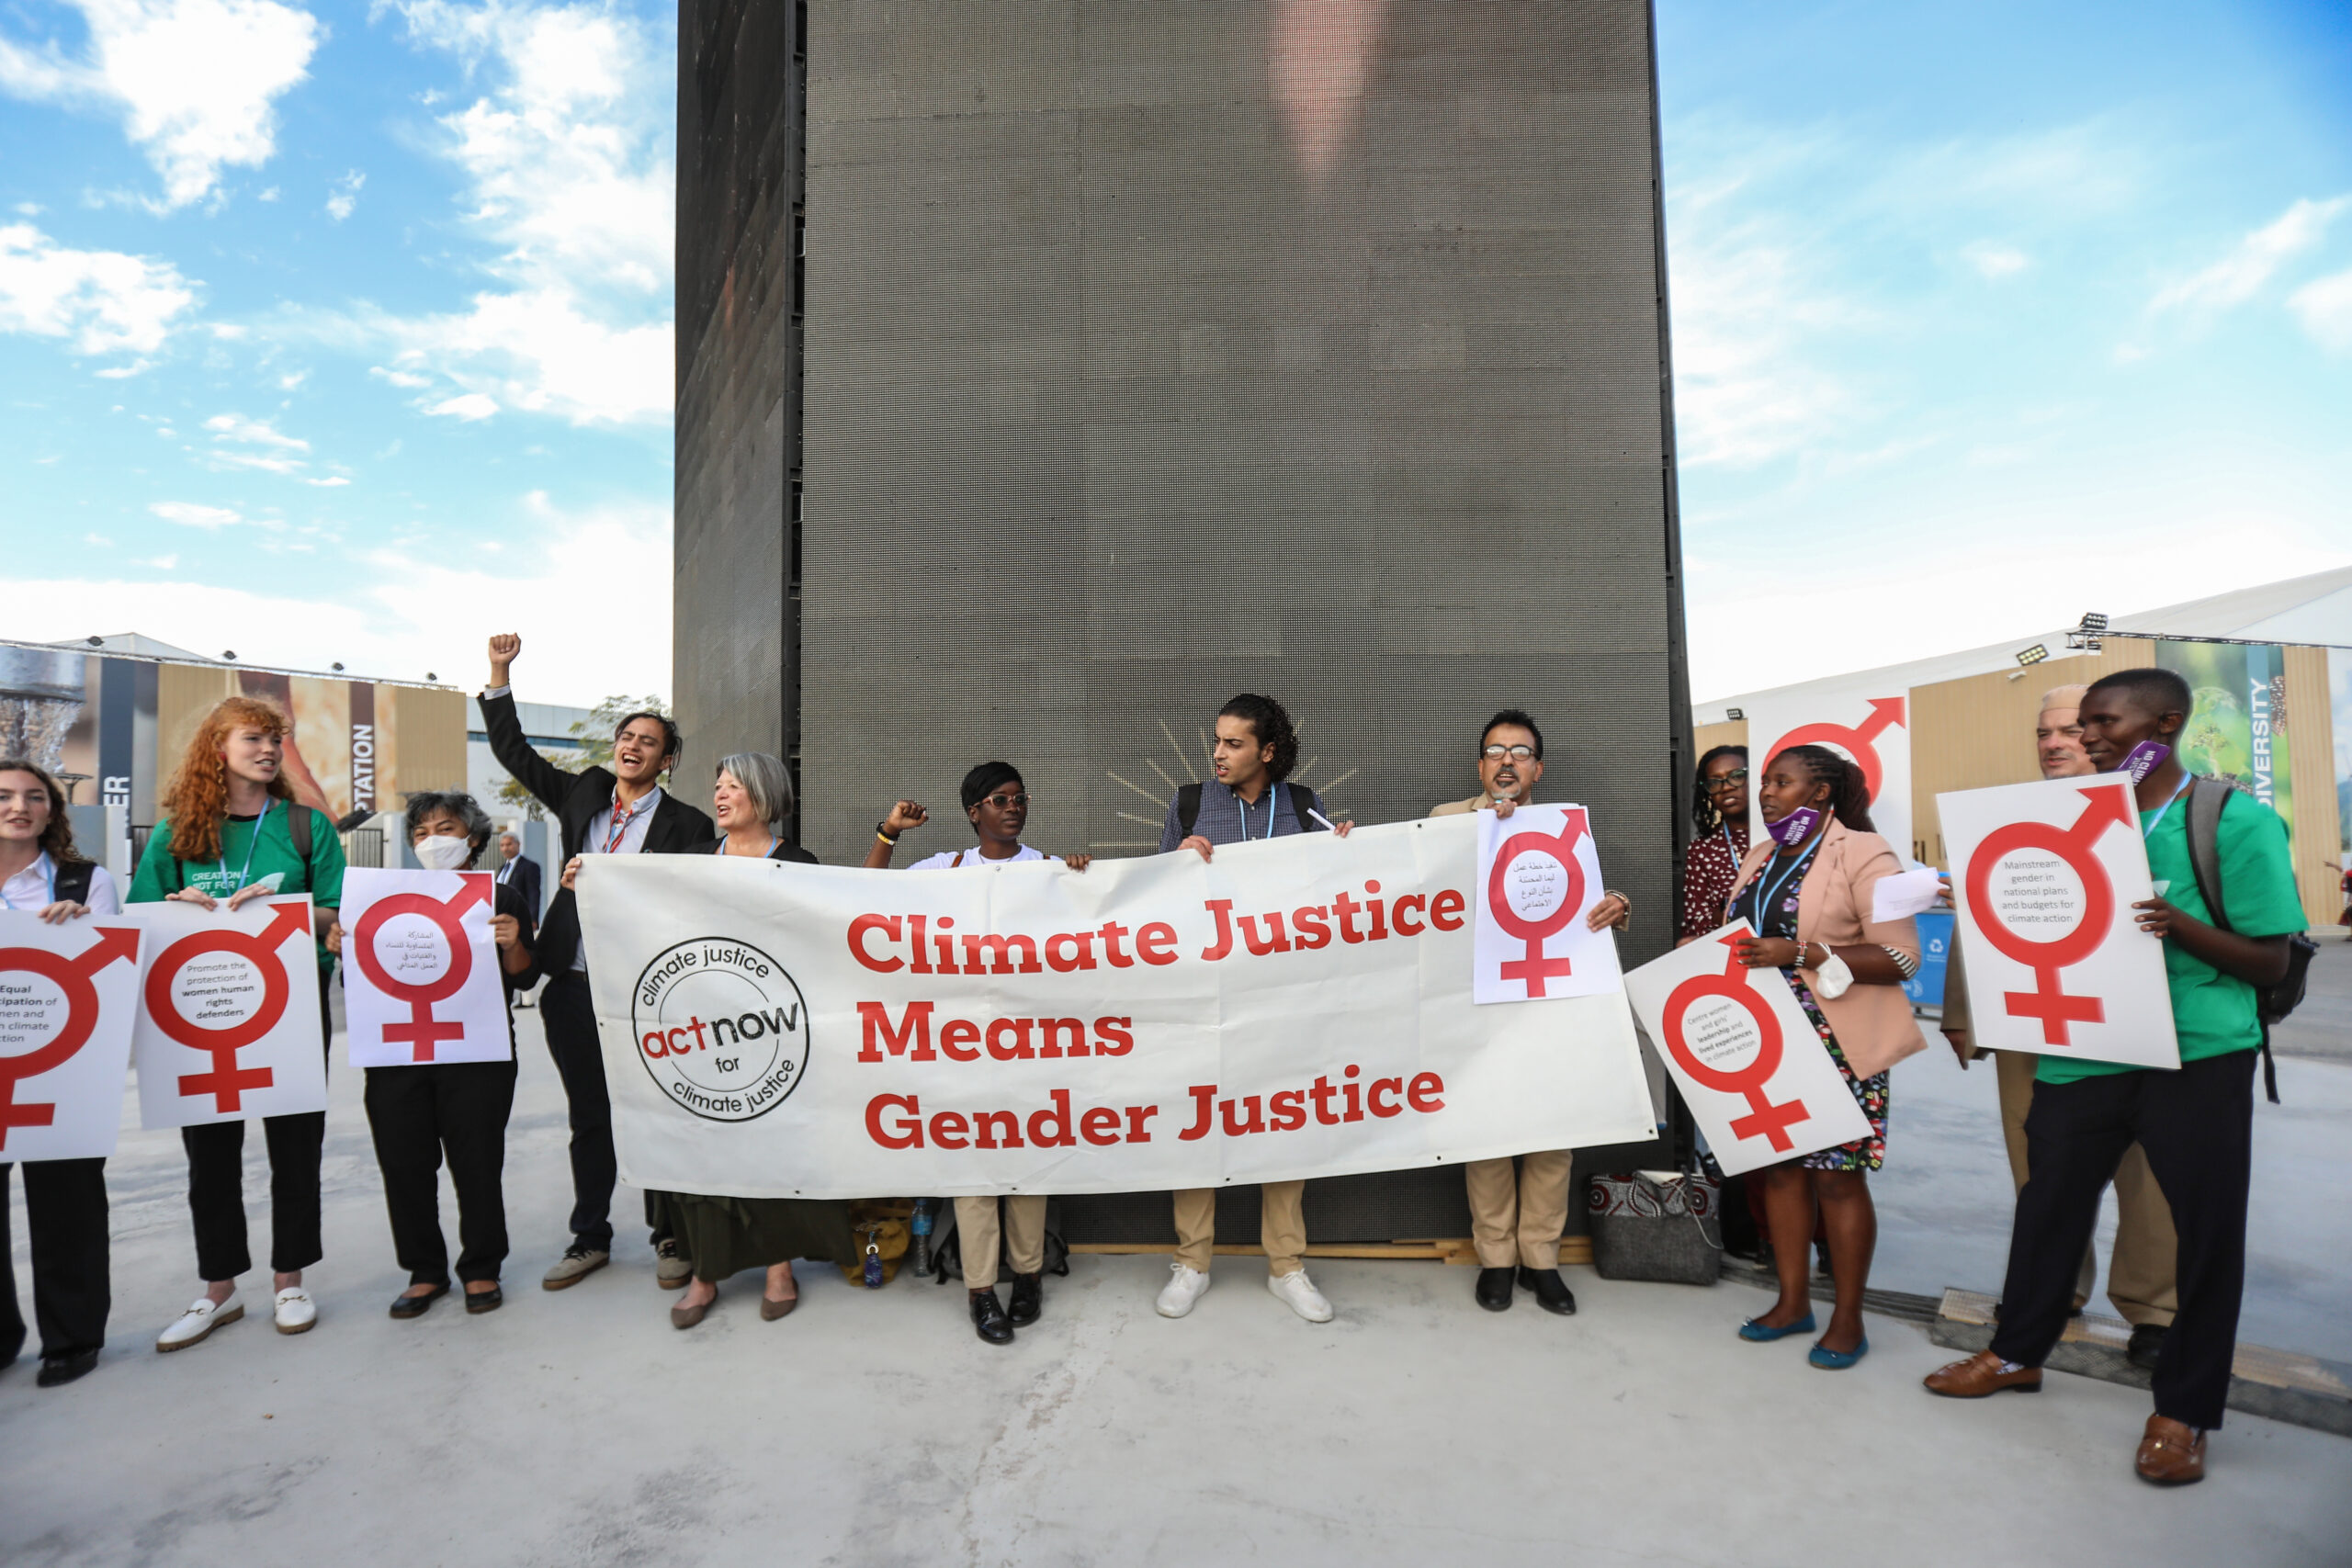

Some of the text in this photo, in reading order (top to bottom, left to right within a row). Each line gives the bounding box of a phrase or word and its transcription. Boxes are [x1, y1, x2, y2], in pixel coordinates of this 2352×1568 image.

[2143, 750, 2156, 761] NO
[2005, 861, 2060, 870] Mainstream
[192, 871, 241, 881] CREATON
[2011, 874, 2055, 885] gender in
[2004, 886, 2069, 897] national plans
[2002, 900, 2074, 910] and budgets for
[2007, 914, 2073, 923] climate action
[848, 879, 1465, 976] Climate Justice
[187, 962, 246, 973] Promote the
[187, 973, 248, 986] protection of
[642, 945, 769, 1007] climate justice
[0, 985, 31, 995] Equal
[182, 986, 254, 997] women human
[0, 998, 58, 1007] ipation of
[206, 998, 233, 1008] rights
[23, 1010, 44, 1018] and
[196, 1010, 245, 1020] defenders
[1688, 1003, 1732, 1025] Centre women
[8, 1021, 50, 1031] climate
[857, 1000, 1134, 1063] Means
[1702, 1021, 1713, 1031] and
[1697, 1021, 1744, 1043] leadership and
[0, 1034, 25, 1043] tion
[1698, 1030, 1753, 1054] lived experiences
[1713, 1047, 1736, 1060] climate
[1736, 1040, 1756, 1052] action
[715, 1057, 740, 1073] for
[673, 1059, 795, 1112] climate justice
[865, 1064, 1444, 1150] Gender Justice
